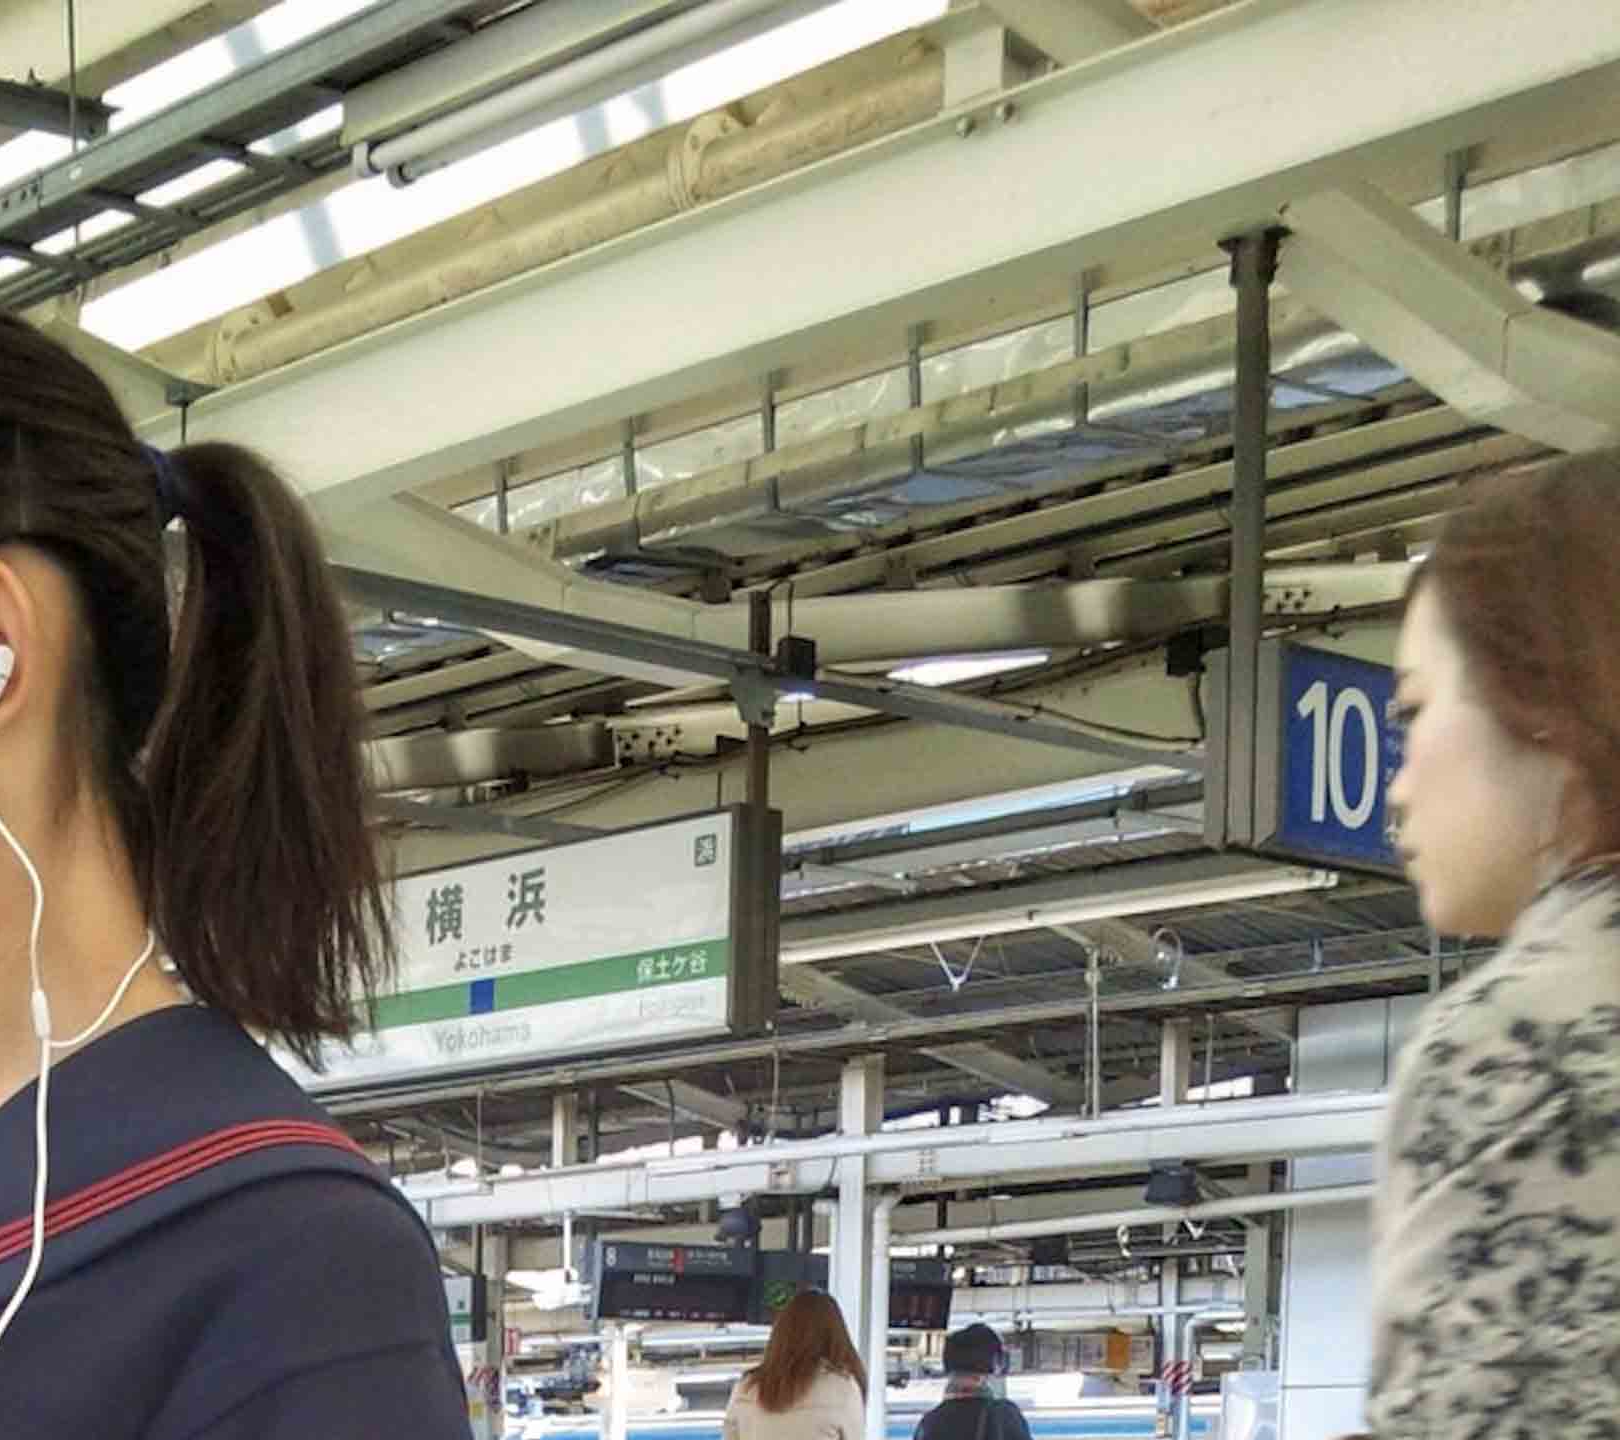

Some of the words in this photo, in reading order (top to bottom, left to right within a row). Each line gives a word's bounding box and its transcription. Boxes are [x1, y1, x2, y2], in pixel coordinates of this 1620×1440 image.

[1296, 680, 1380, 830] 10
[425, 867, 547, 946] 横浜
[453, 943, 516, 971] よこはま
[434, 1023, 532, 1054] Yokohama
